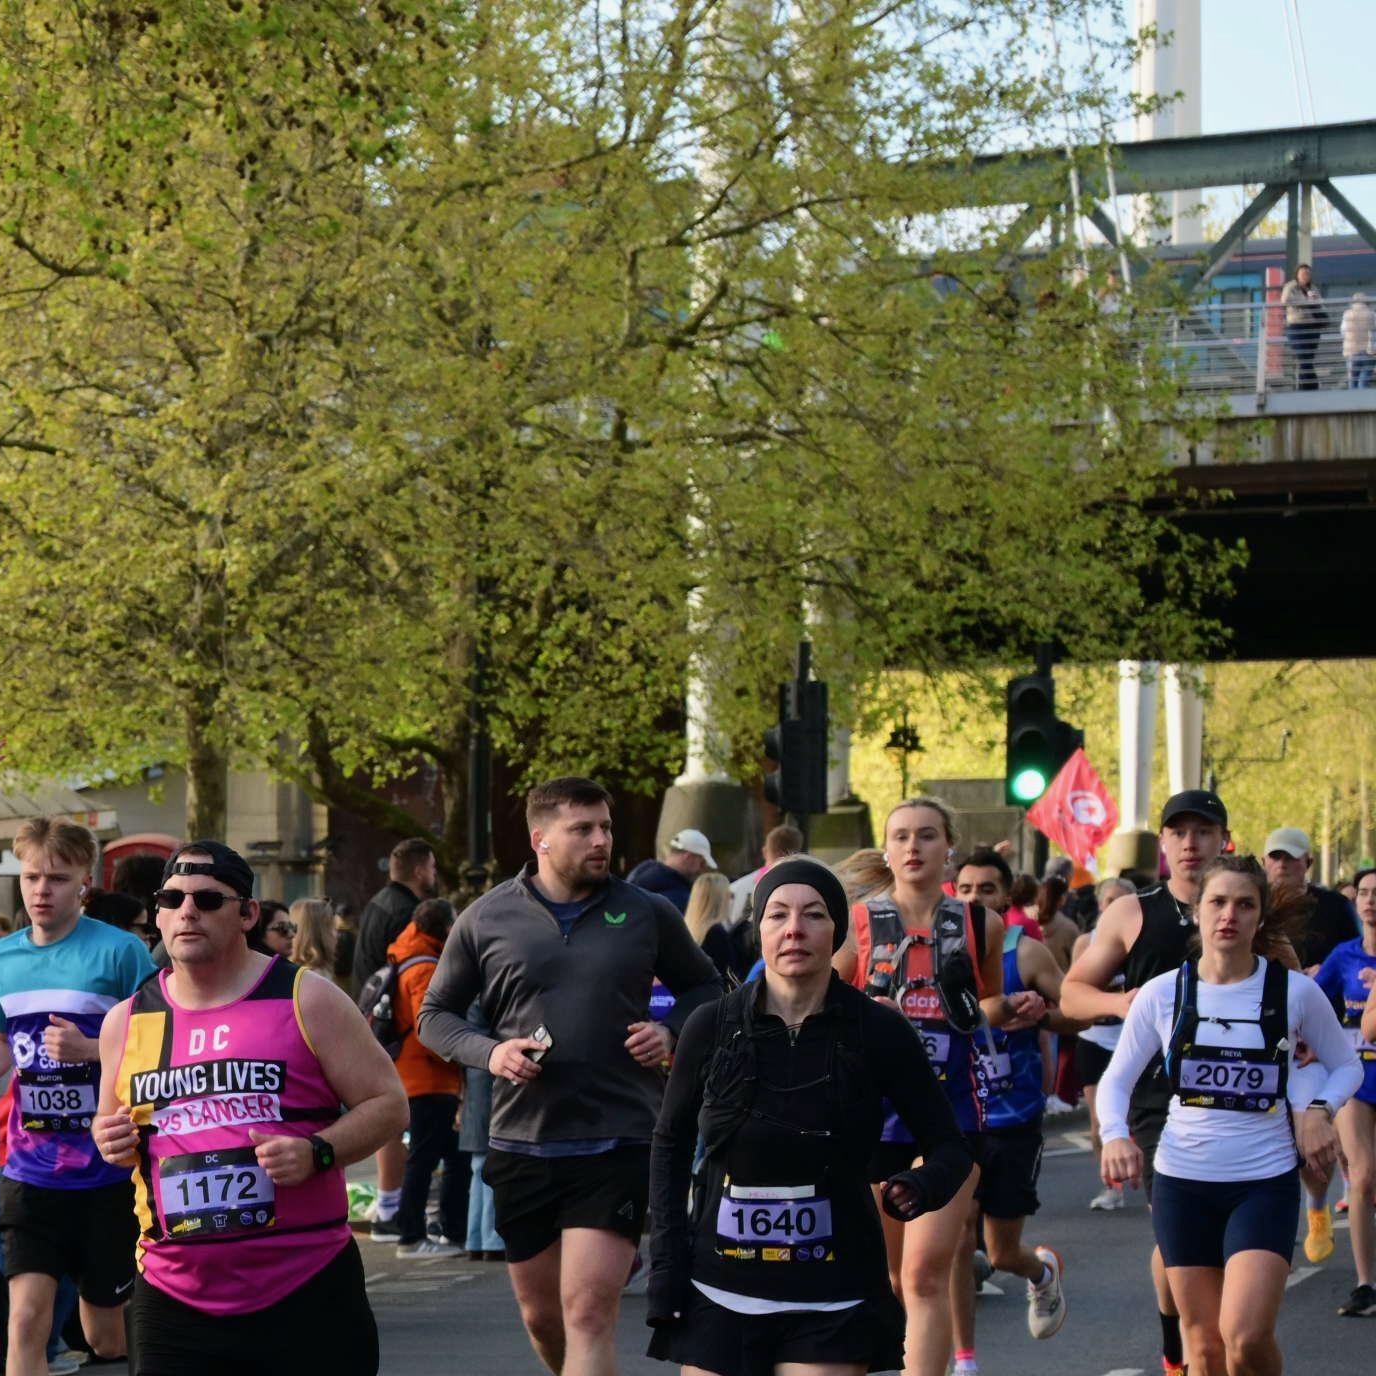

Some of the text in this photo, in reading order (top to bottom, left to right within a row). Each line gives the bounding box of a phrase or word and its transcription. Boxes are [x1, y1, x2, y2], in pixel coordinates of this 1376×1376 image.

[134, 1061, 281, 1103] YOUNG LIVES
[1195, 1064, 1264, 1089] 2079
[29, 1089, 82, 1111] 1038
[183, 1094, 276, 1128] CANCER
[205, 1154, 219, 1163] DC
[177, 1171, 259, 1206] 1172
[731, 1207, 817, 1236] 1640
